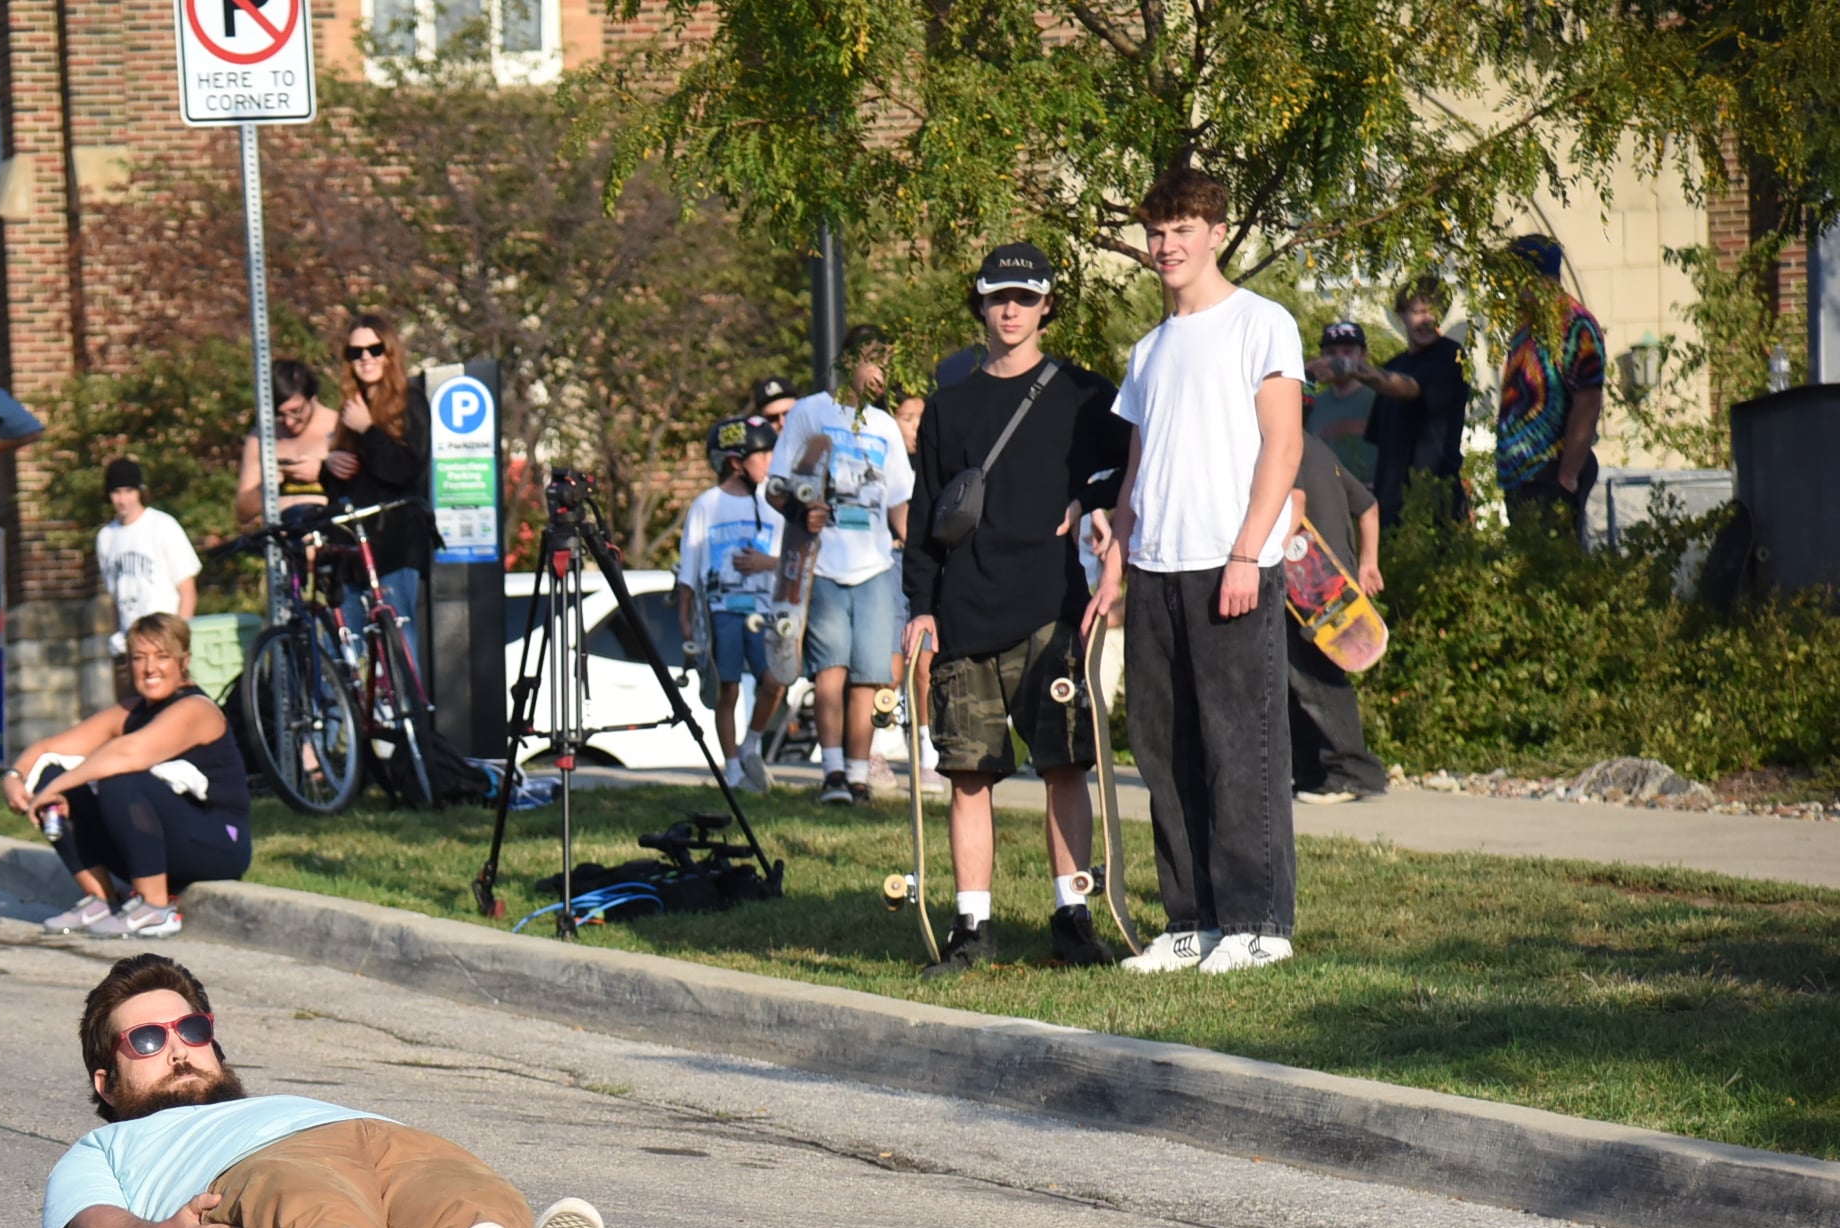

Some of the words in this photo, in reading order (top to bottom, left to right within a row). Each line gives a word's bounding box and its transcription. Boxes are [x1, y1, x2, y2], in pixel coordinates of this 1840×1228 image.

[197, 71, 253, 89] HERE
[270, 69, 296, 87] TO
[205, 92, 291, 111] CORNER
[999, 256, 1034, 270] MAUI
[451, 391, 480, 428] P
